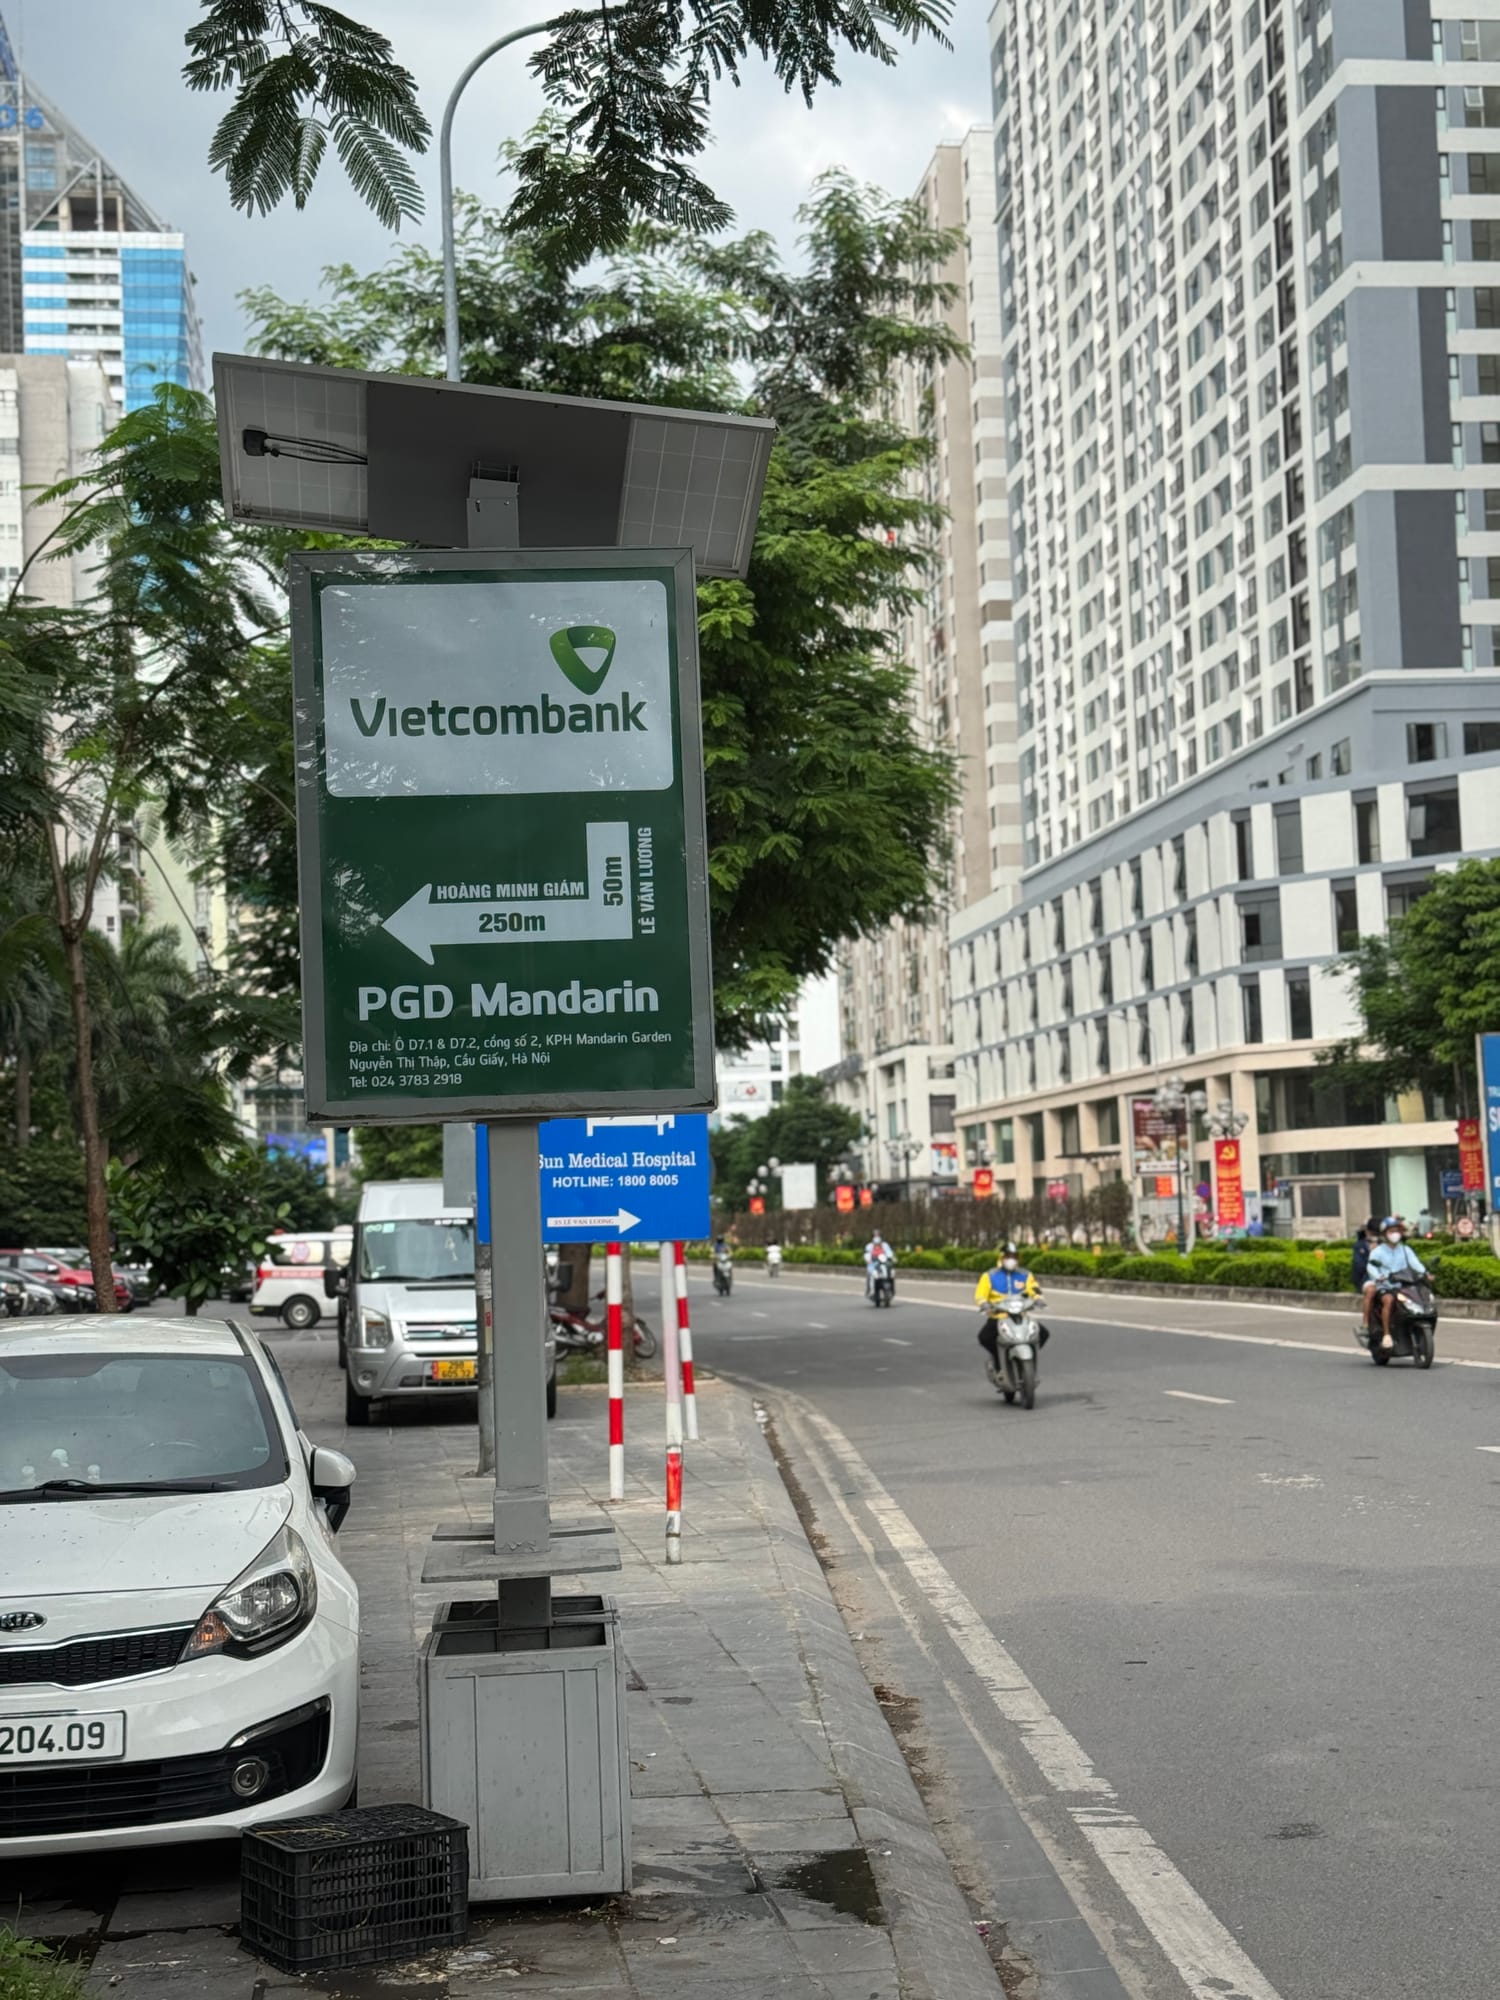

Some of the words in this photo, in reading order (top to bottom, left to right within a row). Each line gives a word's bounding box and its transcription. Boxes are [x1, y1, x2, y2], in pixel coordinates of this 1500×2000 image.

[350, 691, 649, 738] Vietcombank
[636, 827, 654, 877] LƯƠNG
[437, 882, 491, 899] HOÀNG
[496, 883, 538, 898] MINH
[543, 879, 585, 896] GIÁM
[603, 856, 624, 906] 50m
[637, 881, 655, 913] VĂN
[479, 912, 546, 933] 250m
[638, 916, 656, 934] LÊ
[358, 984, 454, 1021] PGD
[471, 980, 659, 1017] Mandarin
[349, 1041, 368, 1055] Địa
[409, 1039, 433, 1050] D7.1
[437, 1038, 446, 1050] &
[450, 1037, 480, 1050] D7.2,
[514, 1033, 528, 1047] số
[530, 1035, 542, 1048] 2,
[546, 1034, 572, 1046] KPH
[576, 1032, 628, 1045] Mandarin
[631, 1031, 672, 1044] Garden
[349, 1055, 393, 1072] Nguyễn
[396, 1057, 415, 1071] Thị
[418, 1055, 450, 1070] Thập,
[479, 1052, 508, 1067] Giấy,
[511, 1052, 528, 1065] Hà
[531, 1052, 550, 1066] Nội
[349, 1076, 368, 1088] Tel:
[371, 1075, 395, 1087] 024
[399, 1074, 430, 1086] 3783
[433, 1073, 462, 1085] 2918
[568, 1152, 628, 1168] Medical
[632, 1151, 697, 1171] Hospital
[552, 1175, 614, 1188] HOTLINE:
[617, 1175, 646, 1187] 1800
[649, 1174, 678, 1186] 8005
[1, 1613, 38, 1627] KIA
[0, 1721, 105, 1755] 204.09
